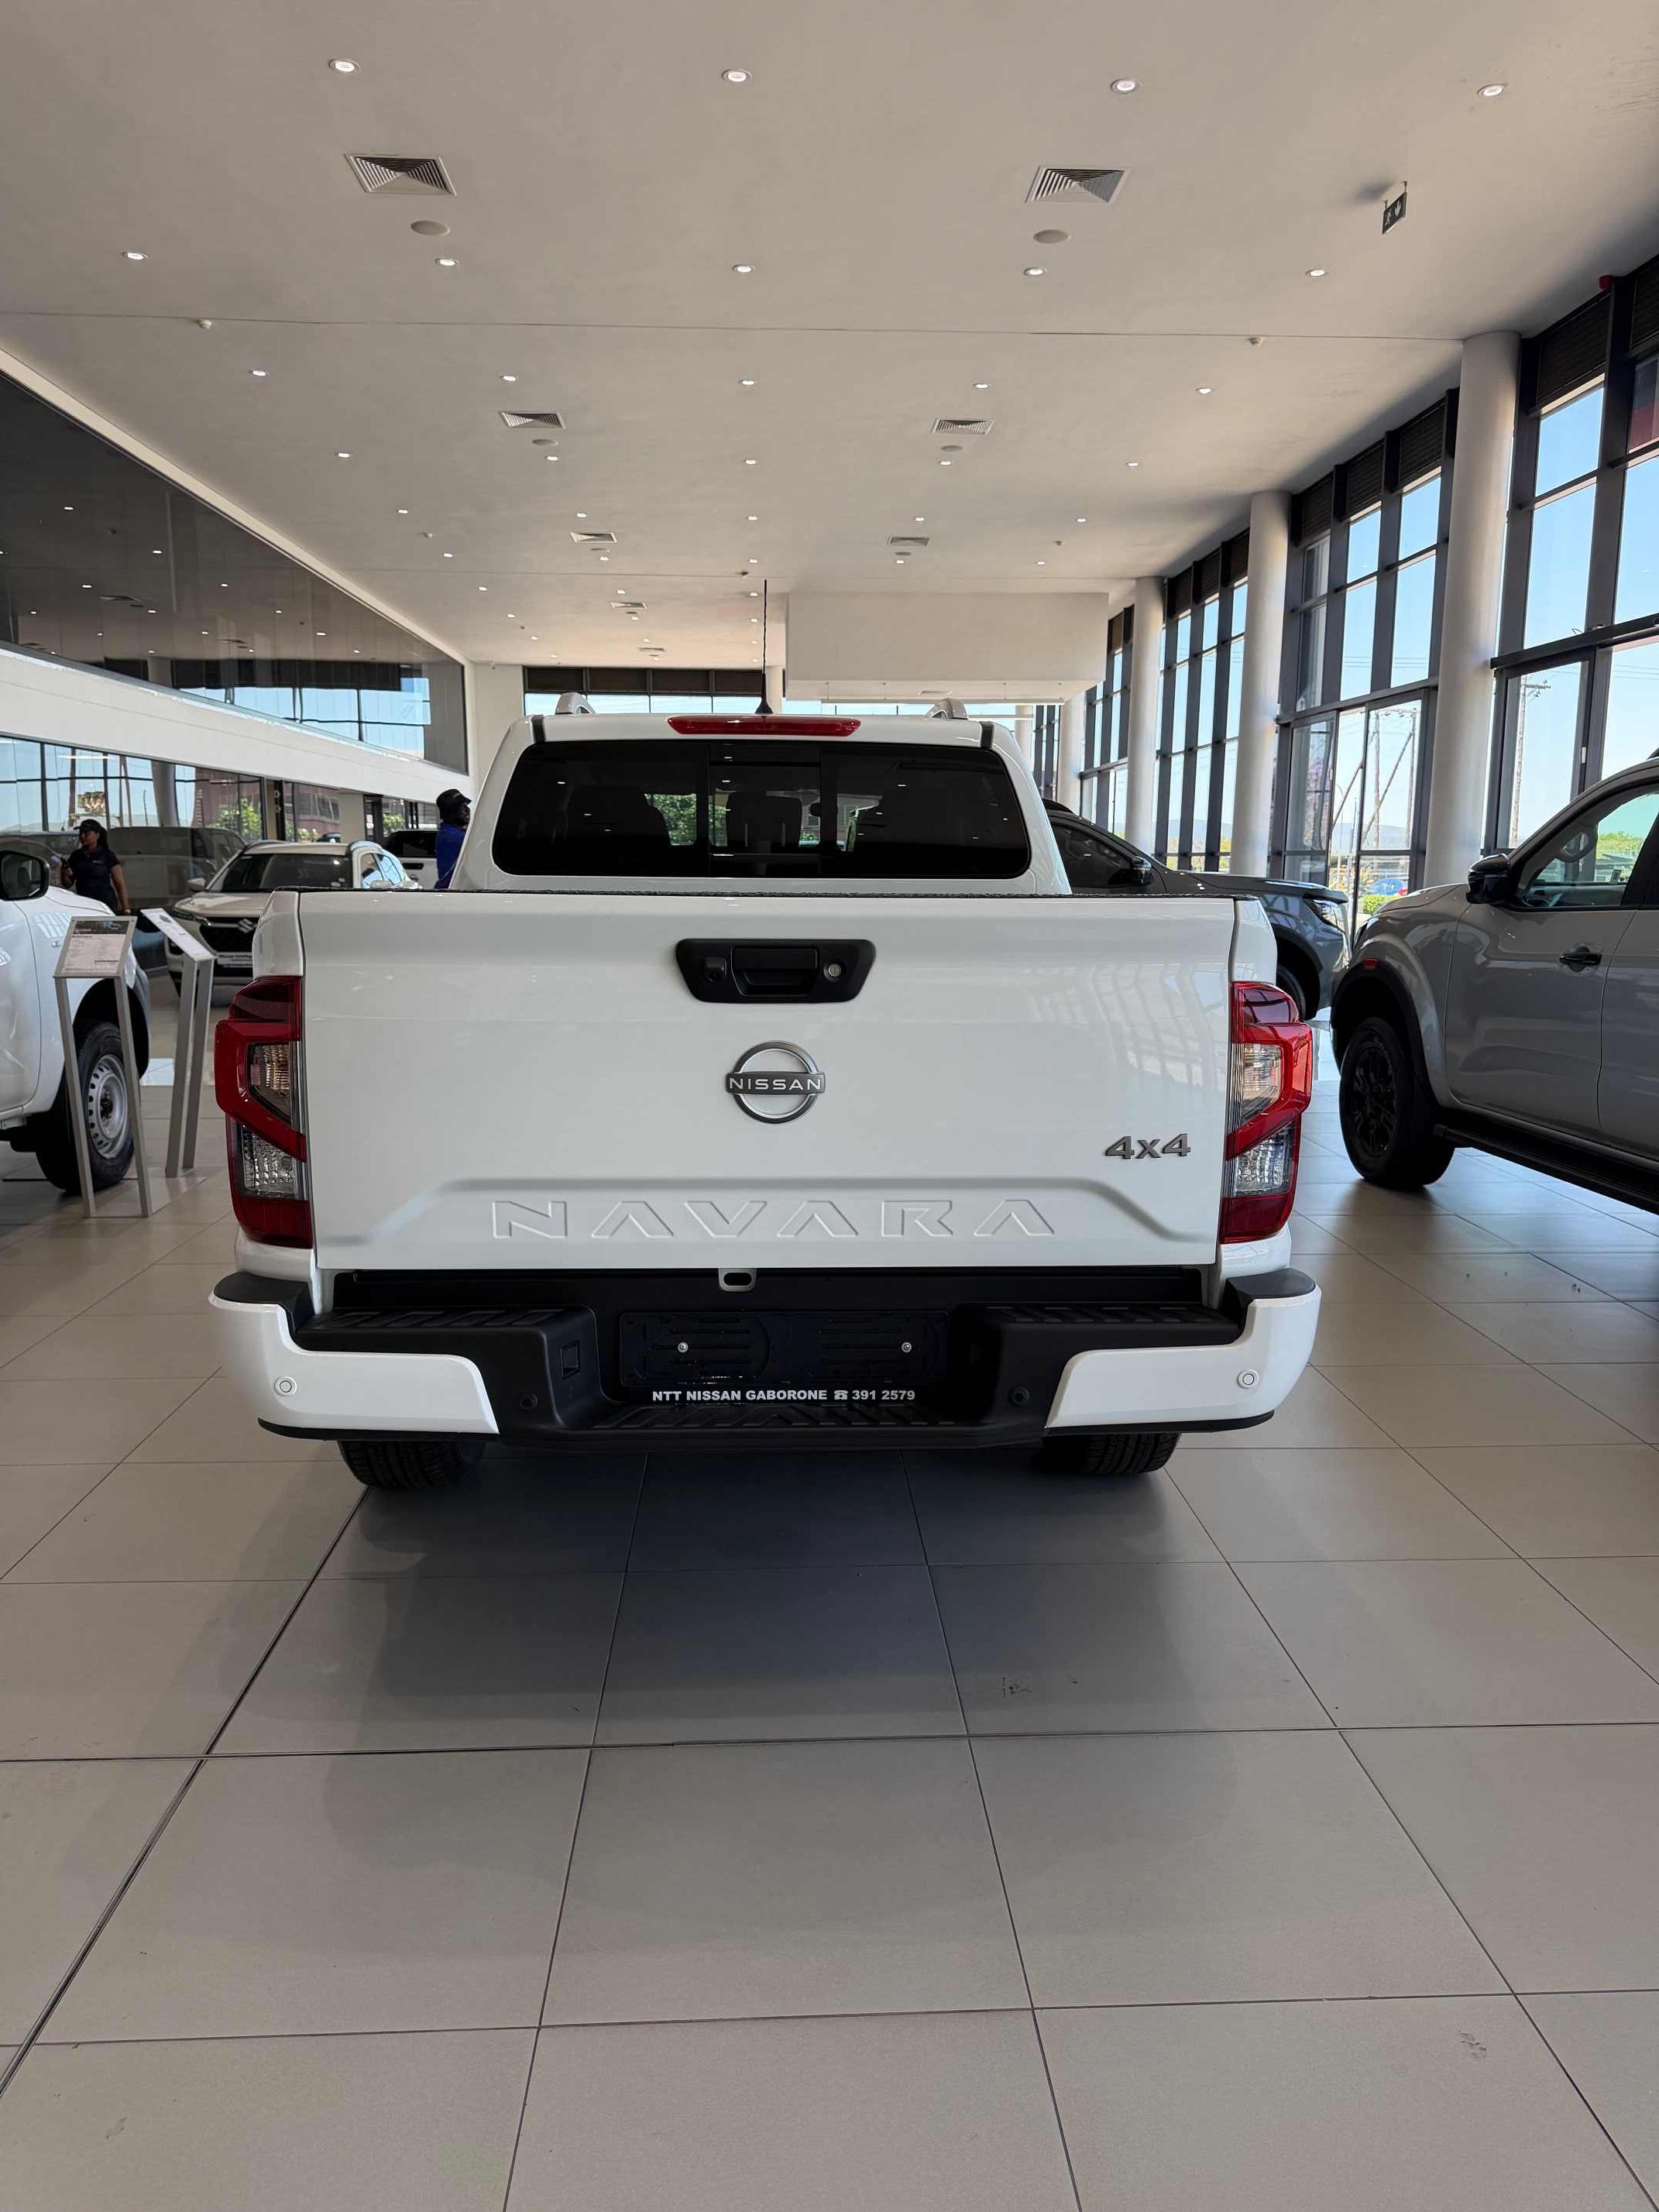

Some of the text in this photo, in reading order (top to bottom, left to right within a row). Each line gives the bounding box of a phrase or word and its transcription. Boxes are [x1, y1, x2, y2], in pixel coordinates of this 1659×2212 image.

[730, 1077, 821, 1091] NISSAN
[491, 1199, 1055, 1238] NAVARA
[652, 1389, 915, 1401] NTT NISSAN GABORONE 391 2579
